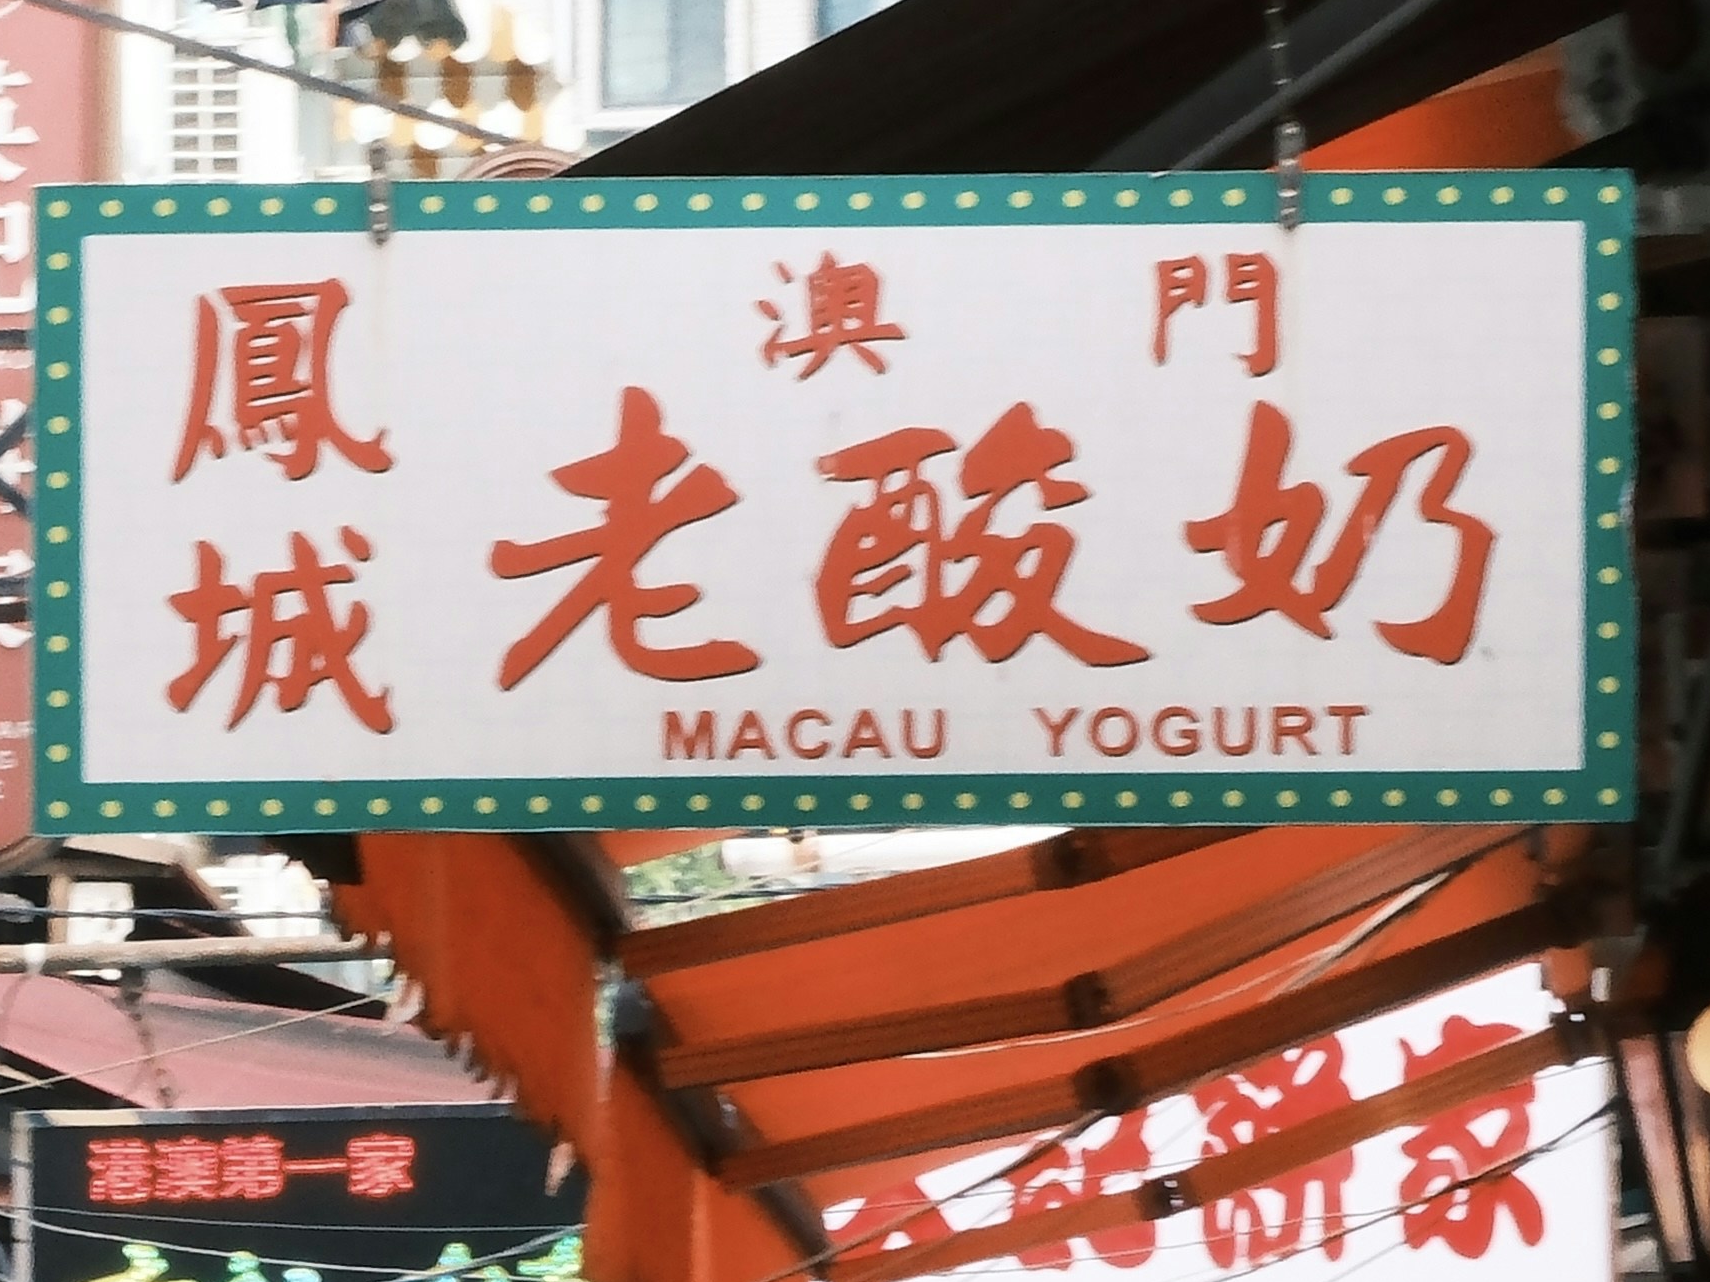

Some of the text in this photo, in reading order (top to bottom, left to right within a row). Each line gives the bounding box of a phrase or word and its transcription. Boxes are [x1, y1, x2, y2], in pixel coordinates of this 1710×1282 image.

[754, 250, 1283, 380] 澳門
[166, 273, 397, 736] 鳳城
[488, 383, 1499, 693] 老酸奶
[661, 704, 1371, 761] MACAU YOGURT
